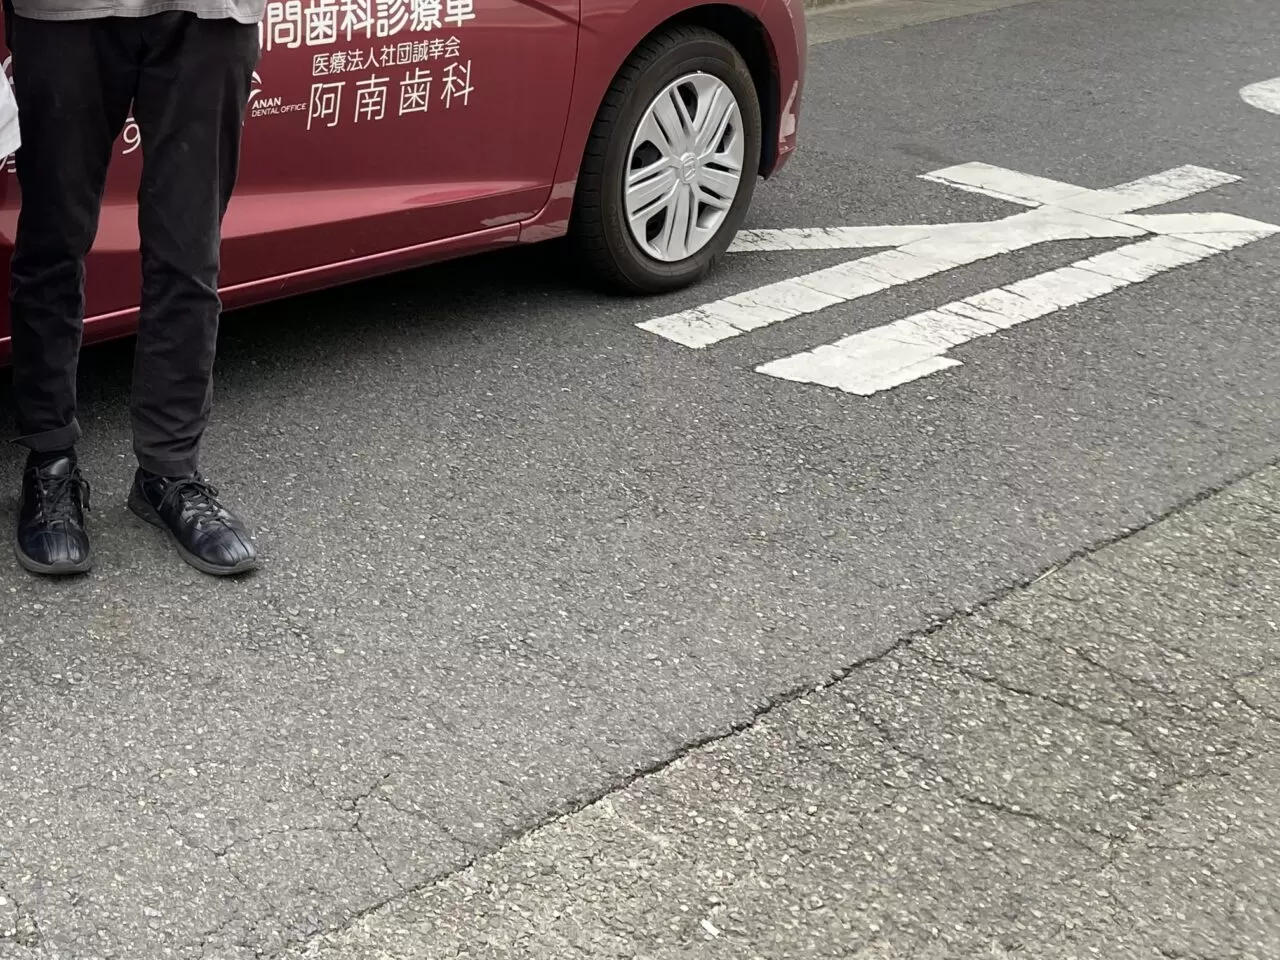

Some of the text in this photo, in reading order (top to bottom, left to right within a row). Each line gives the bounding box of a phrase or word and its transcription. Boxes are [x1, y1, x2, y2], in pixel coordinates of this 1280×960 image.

[312, 36, 461, 77] 医療法人社団誠幸会
[252, 97, 281, 110] ANAN
[252, 102, 307, 117] DENTAL OFFICE
[306, 60, 475, 131] 阿南歯科
